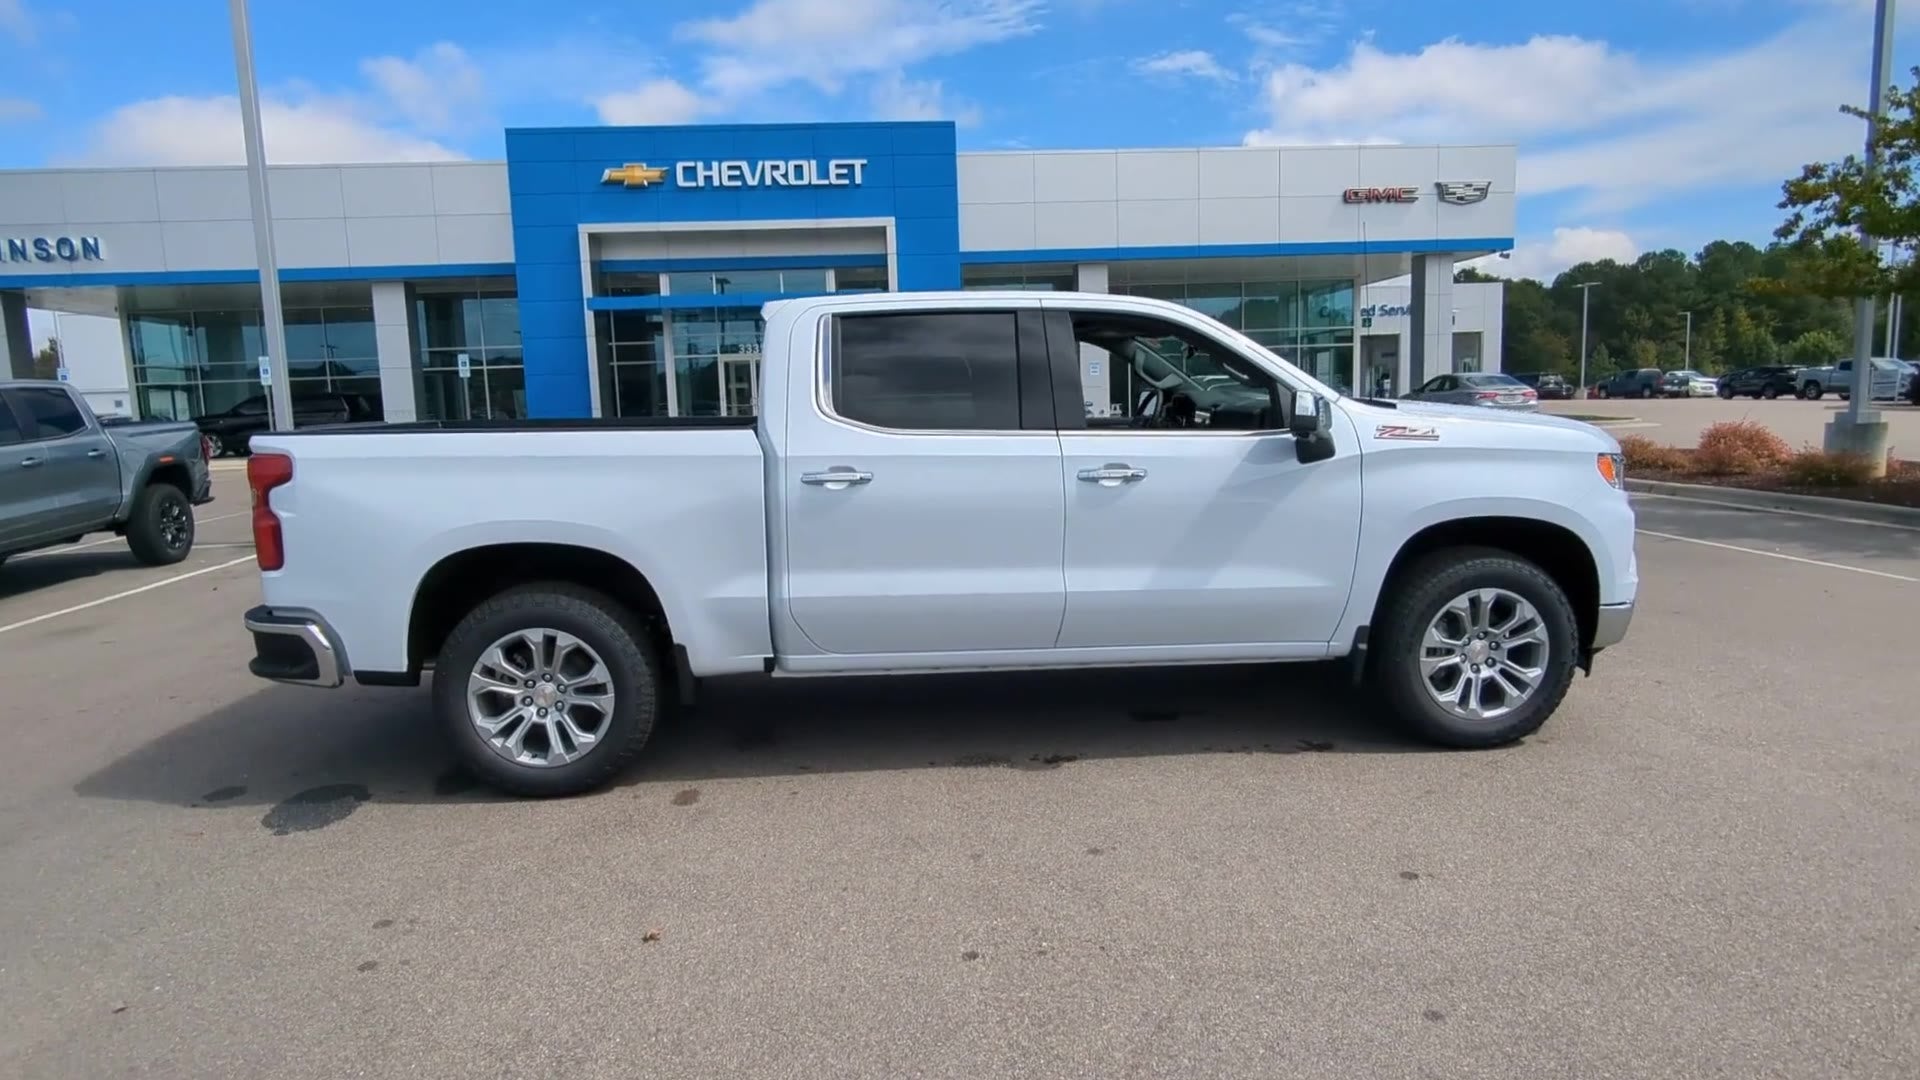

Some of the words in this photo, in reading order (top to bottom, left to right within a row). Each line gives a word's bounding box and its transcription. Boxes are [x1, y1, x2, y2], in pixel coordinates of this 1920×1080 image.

[676, 159, 867, 187] CHEVROLET
[1343, 187, 1419, 203] GMC
[0, 236, 104, 263] NSON
